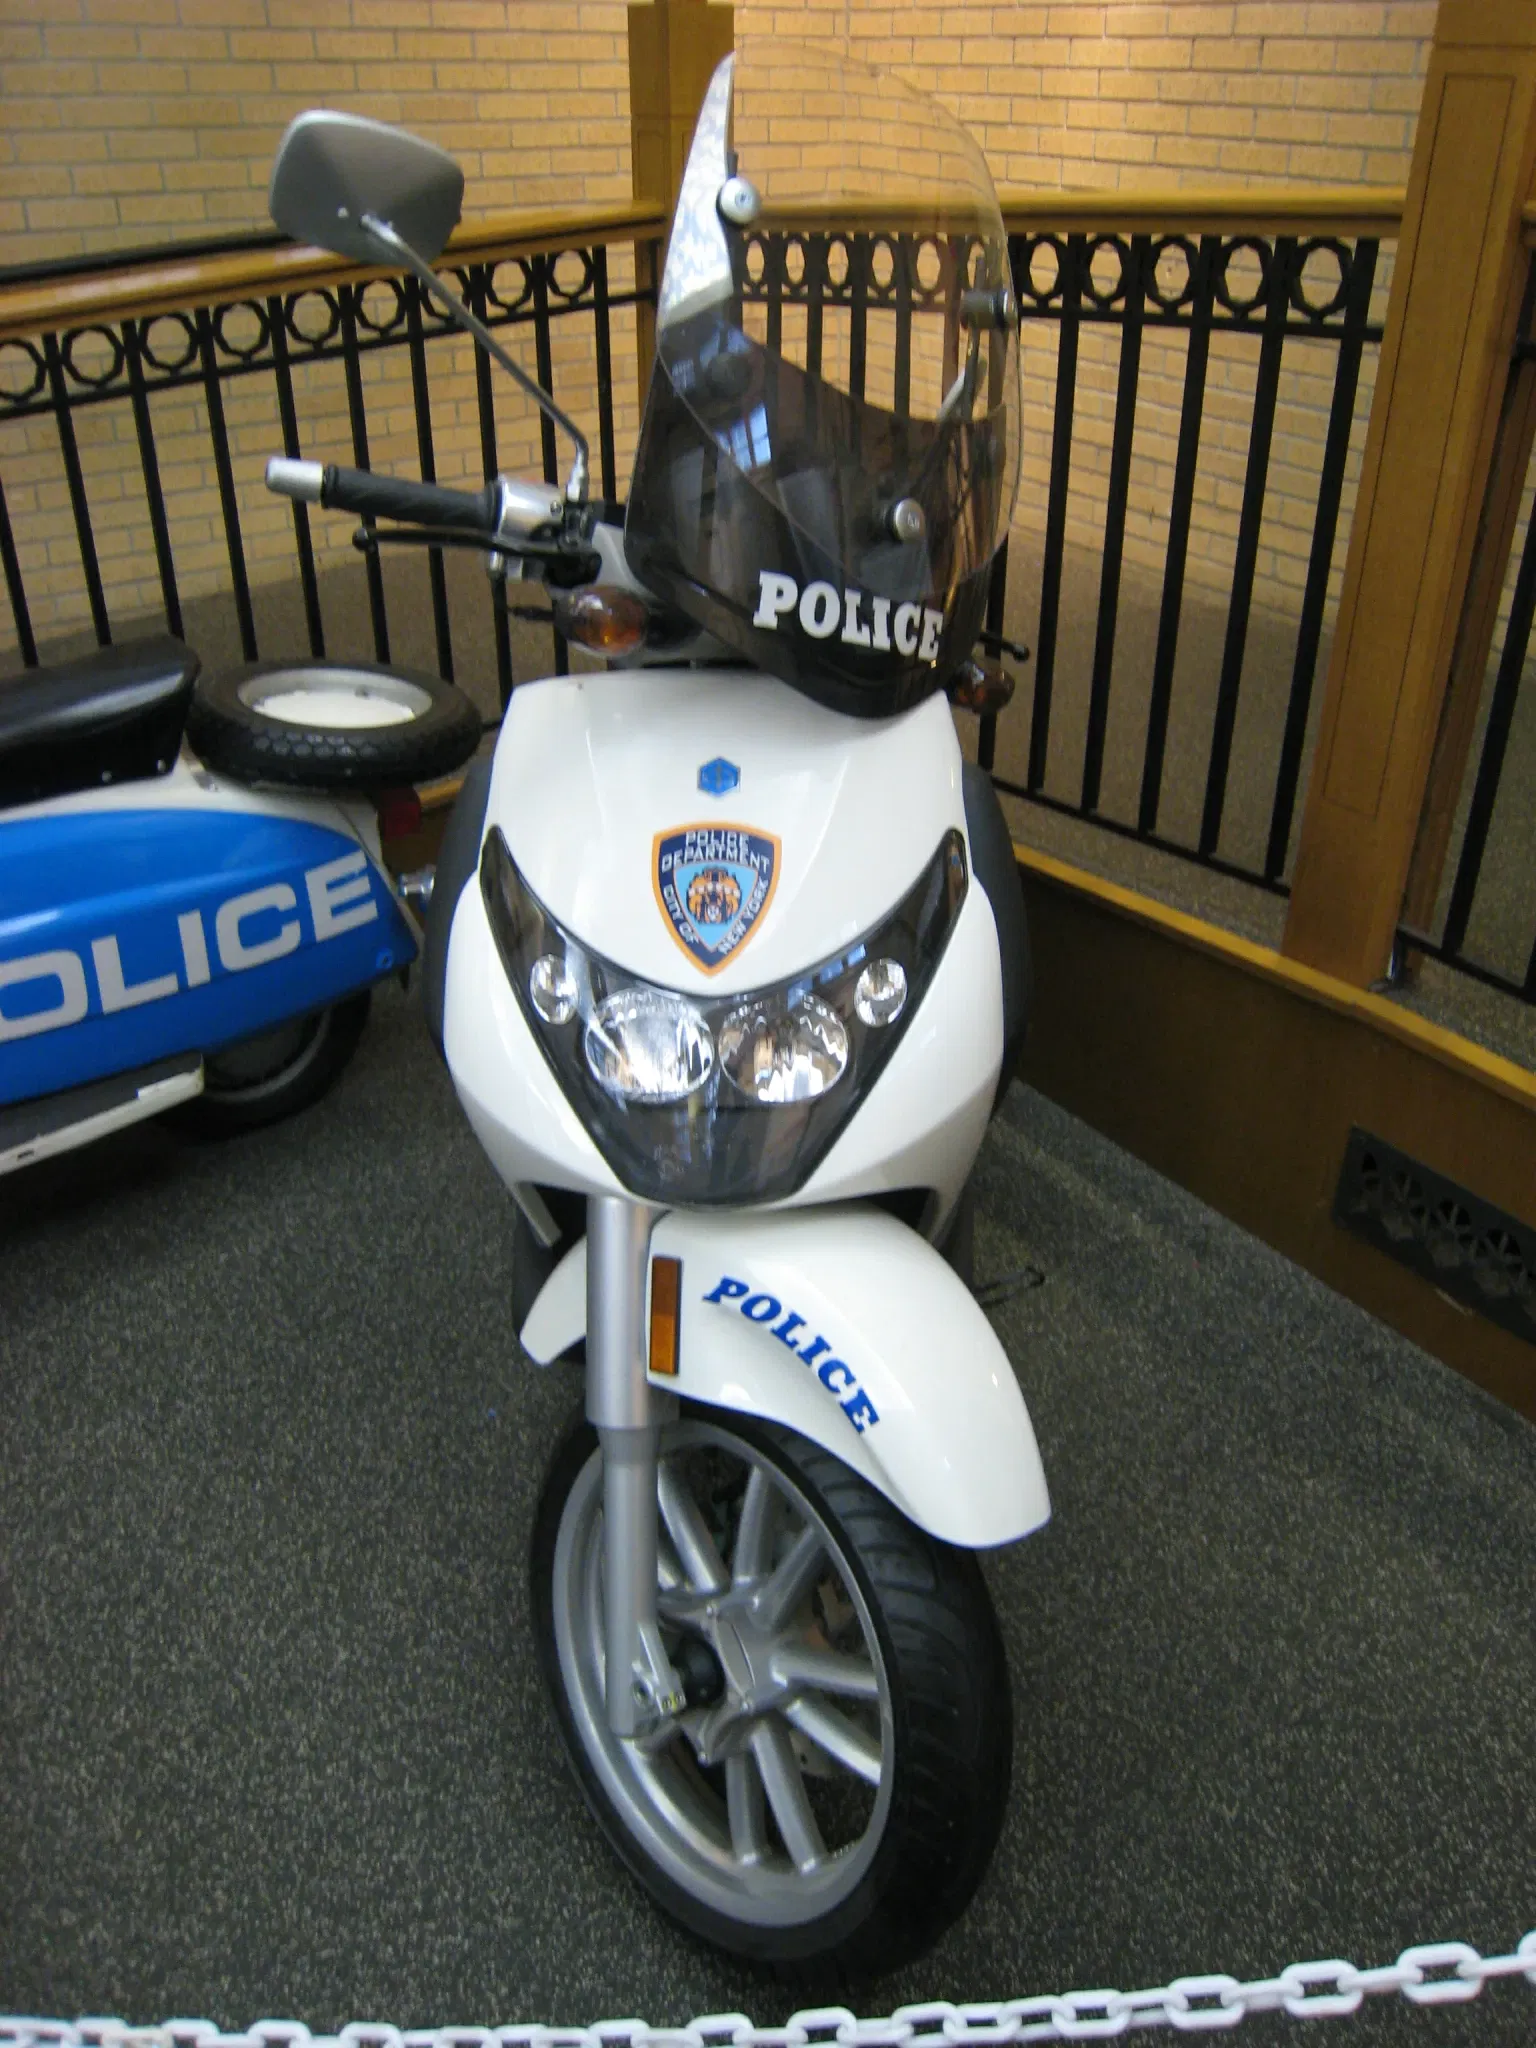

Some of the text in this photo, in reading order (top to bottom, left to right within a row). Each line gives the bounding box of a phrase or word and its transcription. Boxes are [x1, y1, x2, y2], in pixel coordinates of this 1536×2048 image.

[753, 570, 944, 661] POLICE
[661, 844, 770, 873] DEPARTMENT
[685, 829, 749, 850] POLICE
[662, 884, 701, 943] CITY OF
[717, 876, 769, 955] NEW YORK
[702, 1275, 880, 1434] POLICE
